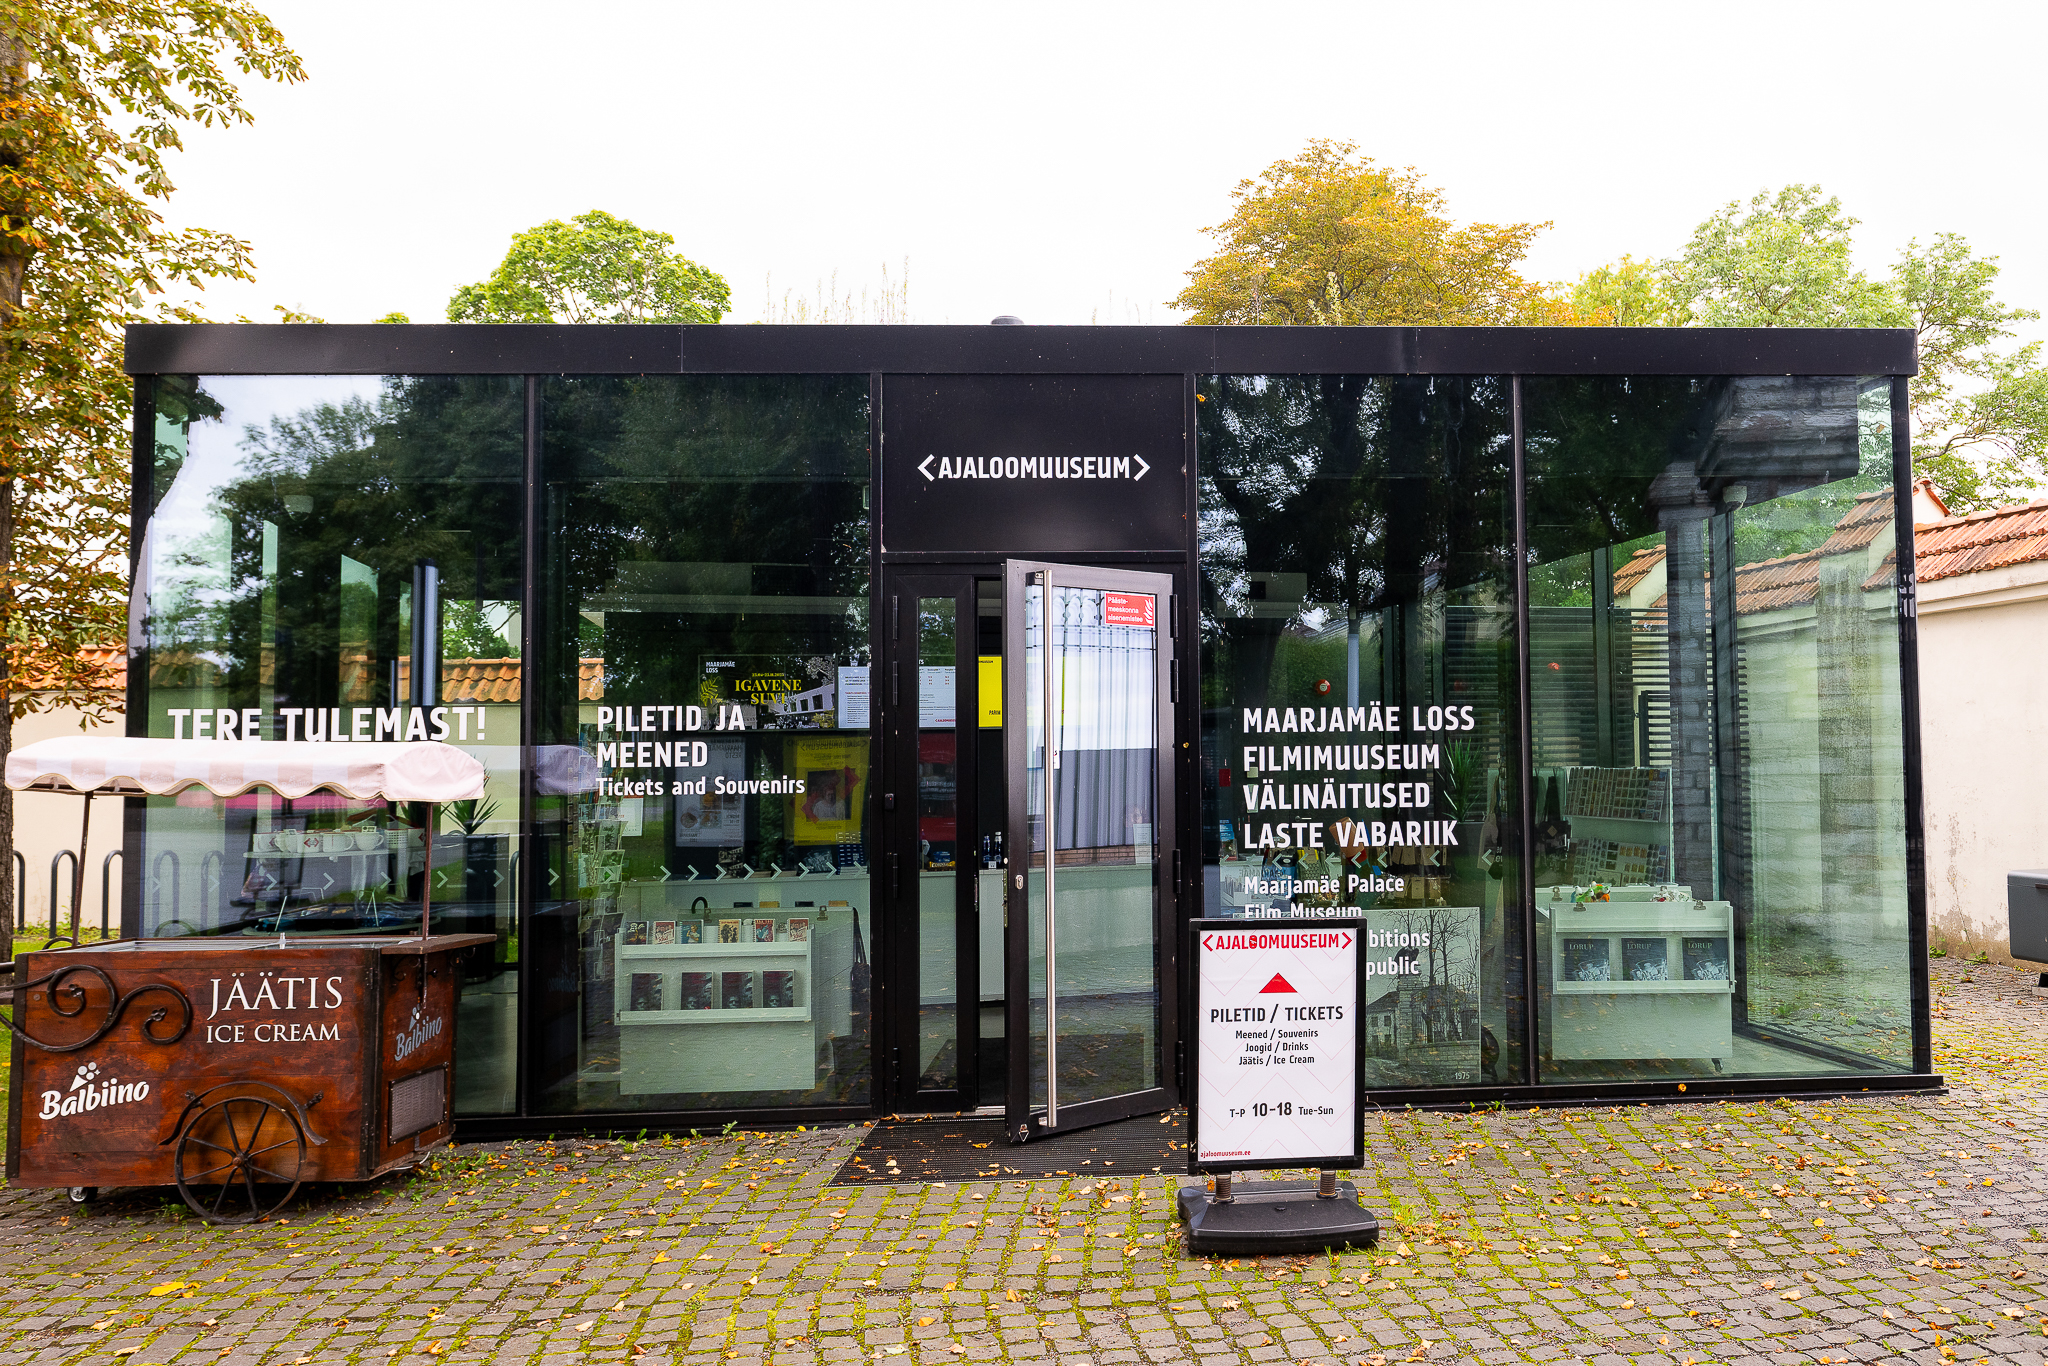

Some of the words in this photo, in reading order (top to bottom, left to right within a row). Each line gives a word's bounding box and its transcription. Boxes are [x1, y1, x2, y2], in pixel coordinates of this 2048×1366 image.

[938, 456, 1130, 479] AJALOOMUUSEUM
[735, 679, 802, 692] IGAVENE
[750, 692, 786, 705] SUVI
[167, 708, 263, 742] TERE
[280, 706, 487, 742] TULEMAST!
[597, 705, 702, 732] PILETID
[715, 705, 746, 732] JA
[1243, 700, 1401, 733] MAARJAMÄE
[1412, 705, 1476, 732] LOSS
[597, 741, 708, 768] MEENED
[1243, 744, 1440, 772] FILMIMUUSEUM
[596, 778, 664, 796] Tickets
[672, 776, 706, 795] and
[714, 774, 805, 795] Souvenirs
[1243, 778, 1431, 810] VÄLINÄITUSED
[1244, 822, 1324, 849] LASTE
[1336, 820, 1459, 848] VABARIIK
[1244, 874, 1340, 899] Maarjamäe
[1348, 874, 1405, 893] Palace
[1216, 933, 1339, 950] AJALOOMUUSEUM
[1368, 928, 1430, 948] bitions
[1569, 943, 1594, 951] LORUP
[1366, 956, 1420, 980] public
[207, 971, 343, 1021] JÄÄTIS
[1210, 1007, 1266, 1023] PILETID
[1285, 1005, 1344, 1022] TICKETS
[206, 1024, 245, 1044] ICE
[254, 1023, 341, 1043] CREAM
[394, 1014, 443, 1062] Balbiino
[1235, 1029, 1268, 1039] Meened
[1278, 1029, 1319, 1039] Souvenirs
[1245, 1042, 1272, 1054] Joogid
[1282, 1042, 1309, 1052] Drinks
[1238, 1055, 1264, 1066] Jäätis
[1274, 1055, 1286, 1065] Ice
[1289, 1055, 1315, 1065] Cream
[1454, 1072, 1471, 1081] 1975
[38, 1077, 150, 1121] Balbiino
[1229, 1108, 1246, 1118] T-P
[1252, 1101, 1293, 1117] 10-18
[1298, 1106, 1334, 1116] Tue-Sun
[1200, 1150, 1251, 1159] ajaloomuuseum.ee
